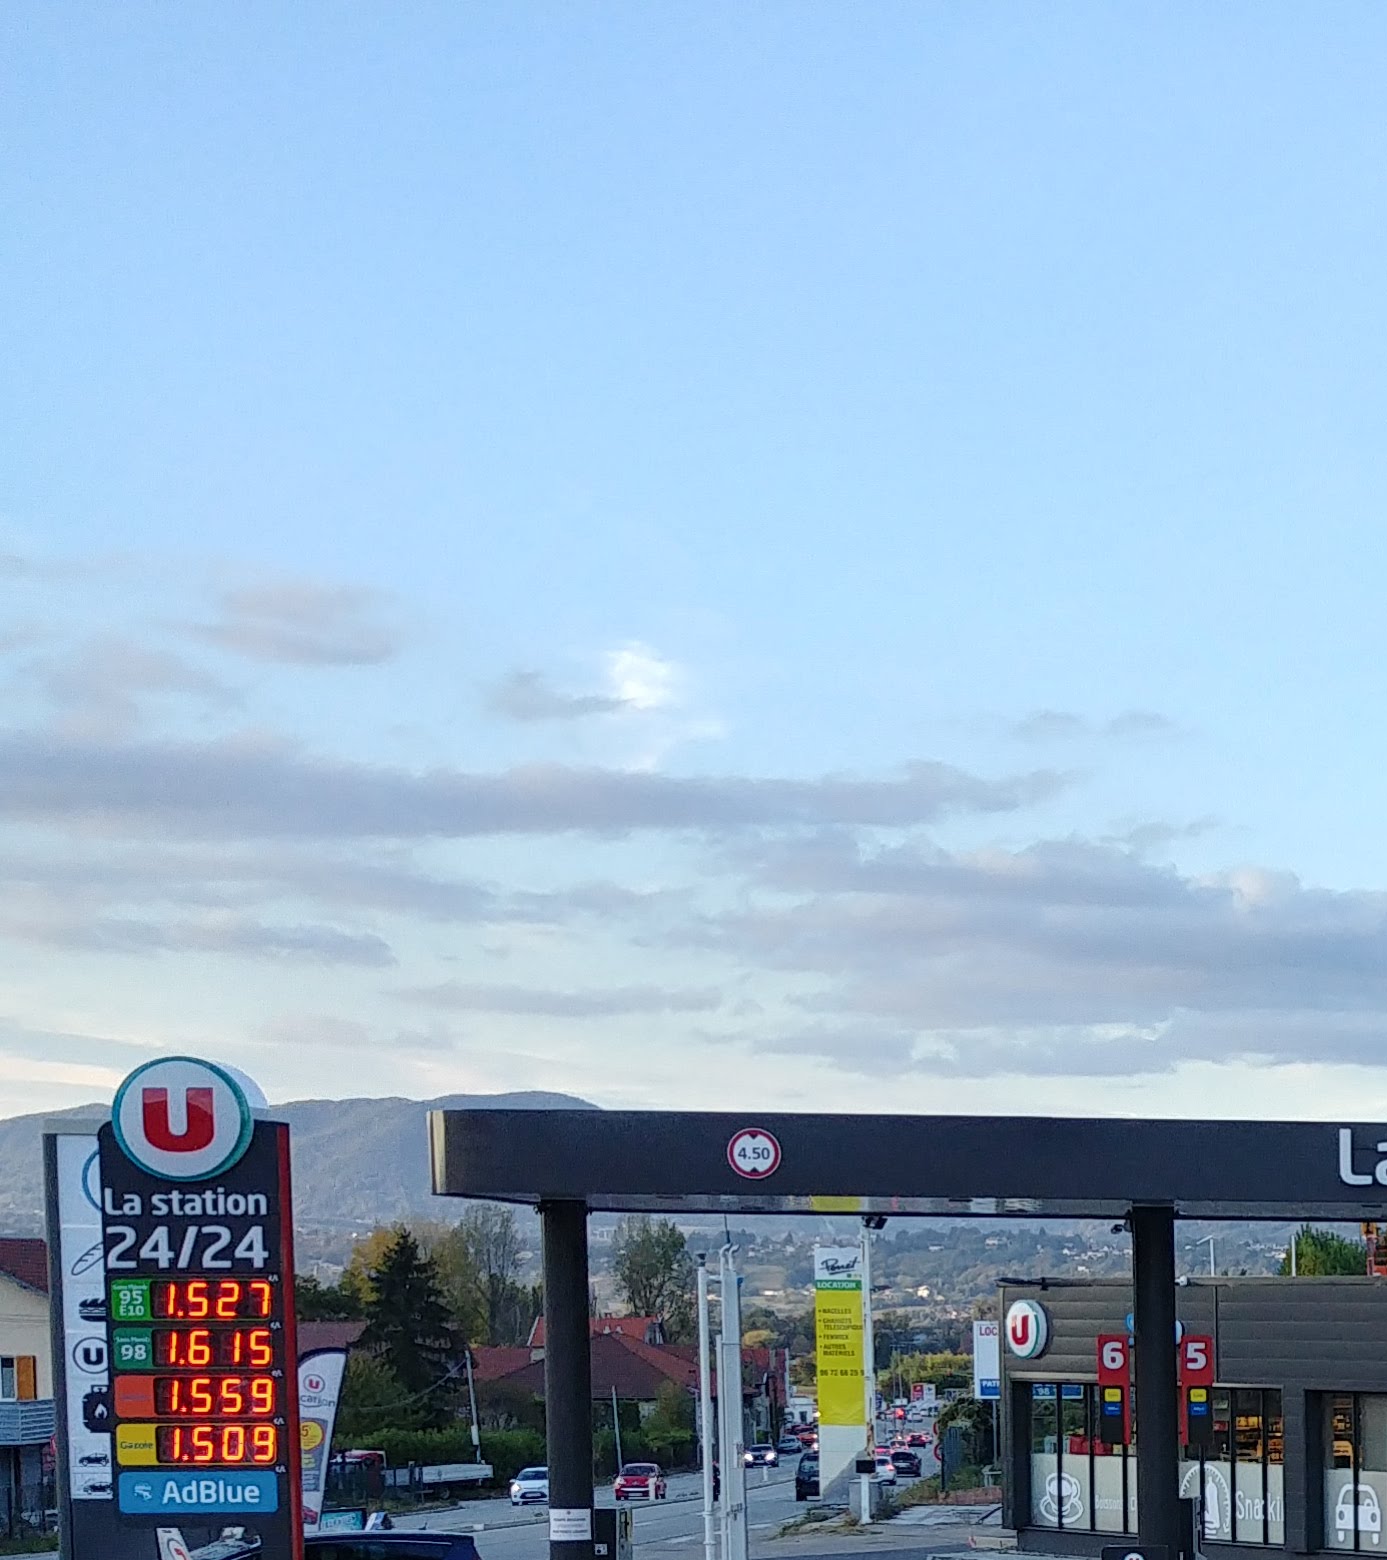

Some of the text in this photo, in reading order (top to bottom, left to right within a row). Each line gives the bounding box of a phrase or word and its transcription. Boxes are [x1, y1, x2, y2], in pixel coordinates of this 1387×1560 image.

[142, 1088, 214, 1152] U
[738, 1147, 771, 1161] 4.50
[104, 1188, 268, 1216] La station
[106, 1226, 269, 1269] 24/24
[119, 1290, 143, 1304] 95
[167, 1281, 271, 1317] 1.527
[816, 1281, 856, 1289] LOCATION
[119, 1305, 145, 1316] E10
[1012, 1314, 1029, 1345] U
[121, 1344, 147, 1360] 98
[169, 1330, 272, 1366] 1.615
[1102, 1341, 1124, 1370] 6
[1186, 1342, 1207, 1370] 5
[172, 1378, 273, 1413] 1.559
[173, 1427, 276, 1461] 1.509
[162, 1480, 260, 1504] AdBlue
